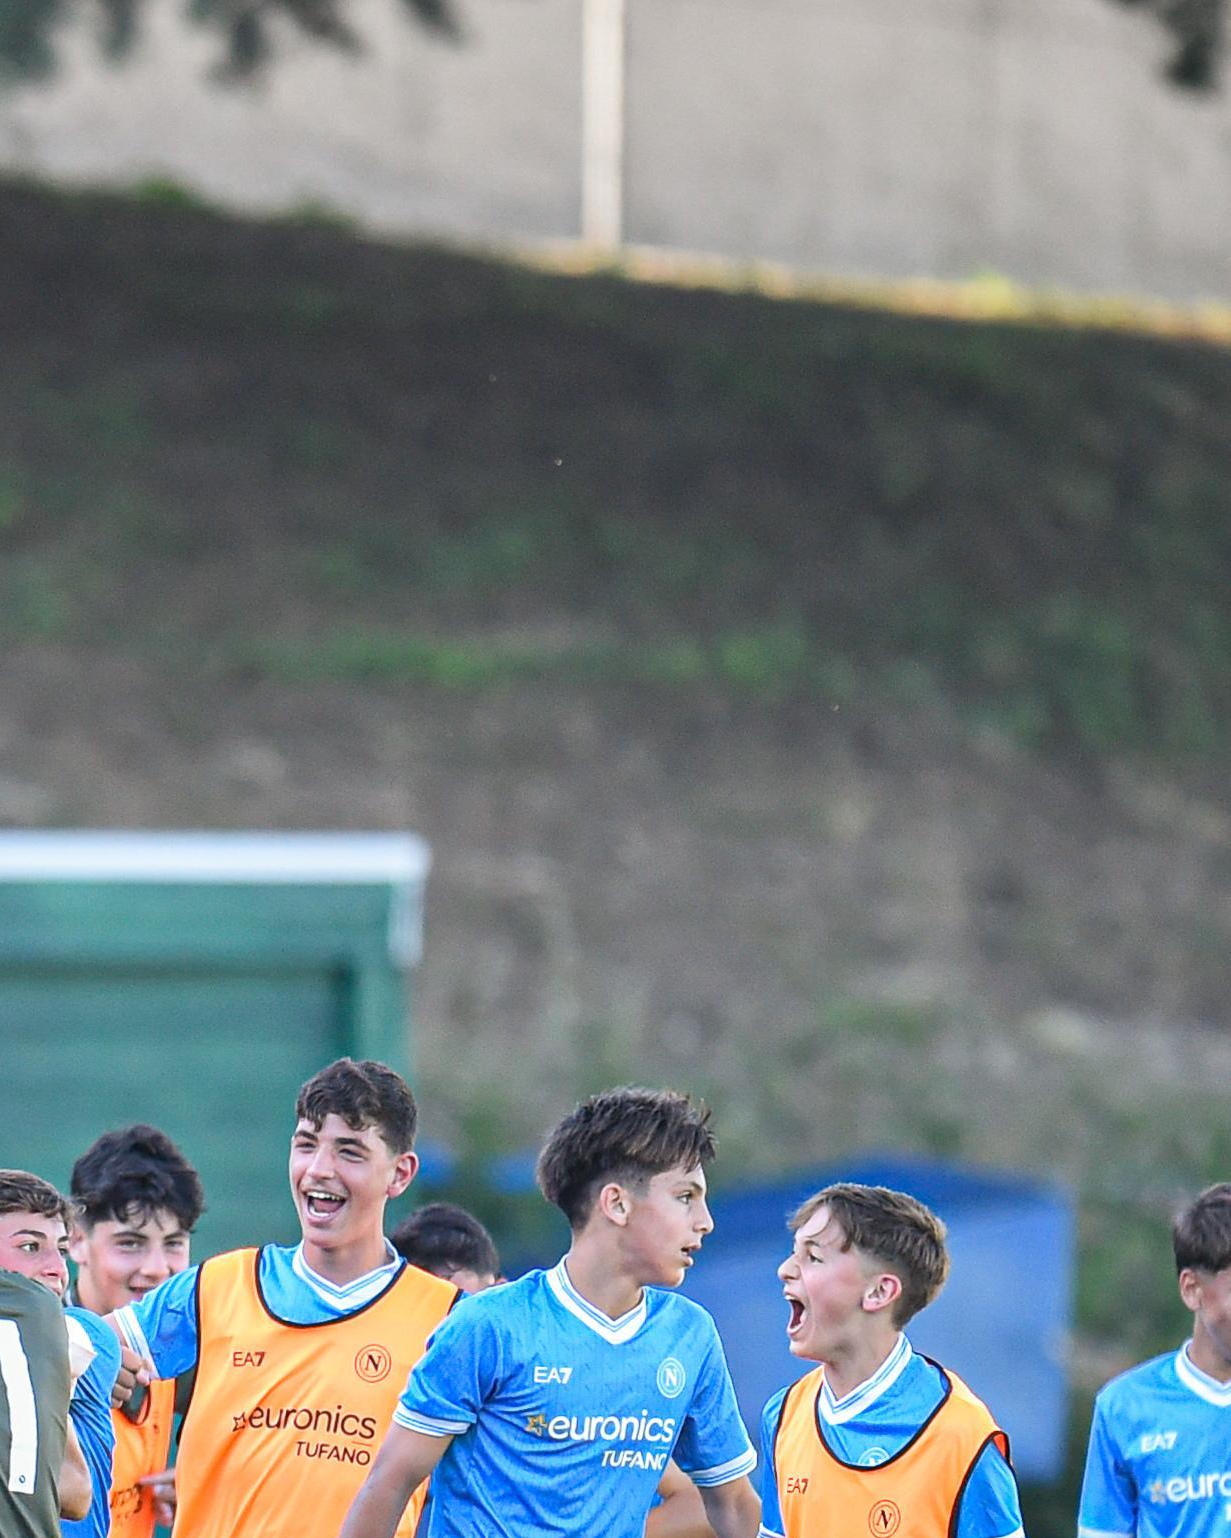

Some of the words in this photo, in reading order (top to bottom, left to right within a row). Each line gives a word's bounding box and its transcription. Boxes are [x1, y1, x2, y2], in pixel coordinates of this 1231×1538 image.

[233, 1351, 266, 1367] EA7
[364, 1354, 381, 1372] N
[534, 1366, 573, 1385] EA7
[664, 1367, 678, 1387] N
[248, 1404, 377, 1440] euronics
[548, 1409, 676, 1442] euronics
[1141, 1431, 1178, 1453] EA7
[296, 1441, 371, 1466] TUFANO
[786, 1477, 809, 1494] EA7
[875, 1509, 893, 1530] N
